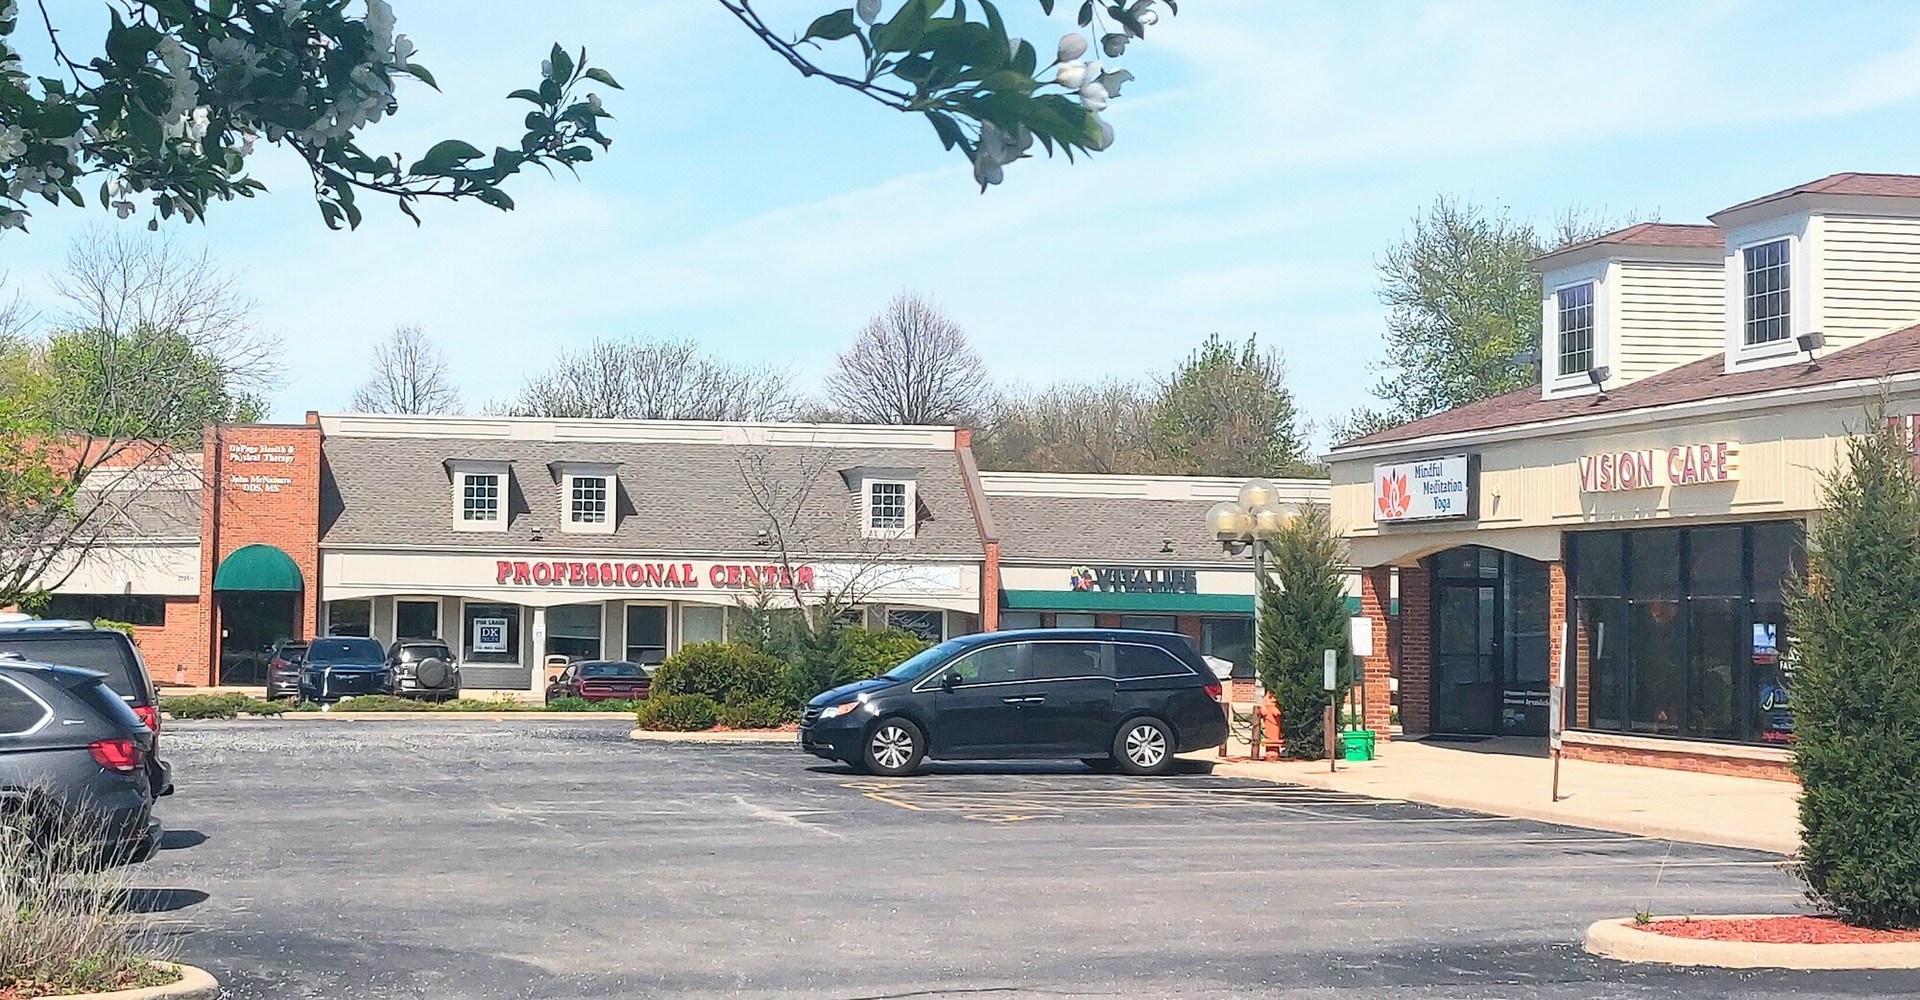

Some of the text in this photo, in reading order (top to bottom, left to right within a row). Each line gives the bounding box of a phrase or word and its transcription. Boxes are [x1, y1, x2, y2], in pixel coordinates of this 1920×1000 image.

[259, 444, 287, 454] Health
[287, 444, 296, 455] &
[229, 453, 295, 464] Physical Therapy
[1414, 462, 1444, 479] Mindful
[1578, 442, 1728, 492] VISION CARE
[230, 475, 249, 483] John
[264, 484, 281, 493] MS
[1423, 478, 1463, 495] Meditation
[1433, 496, 1451, 513] Yoga
[496, 561, 815, 591] PROFESSIONAL CENTER
[482, 628, 499, 637] DK
